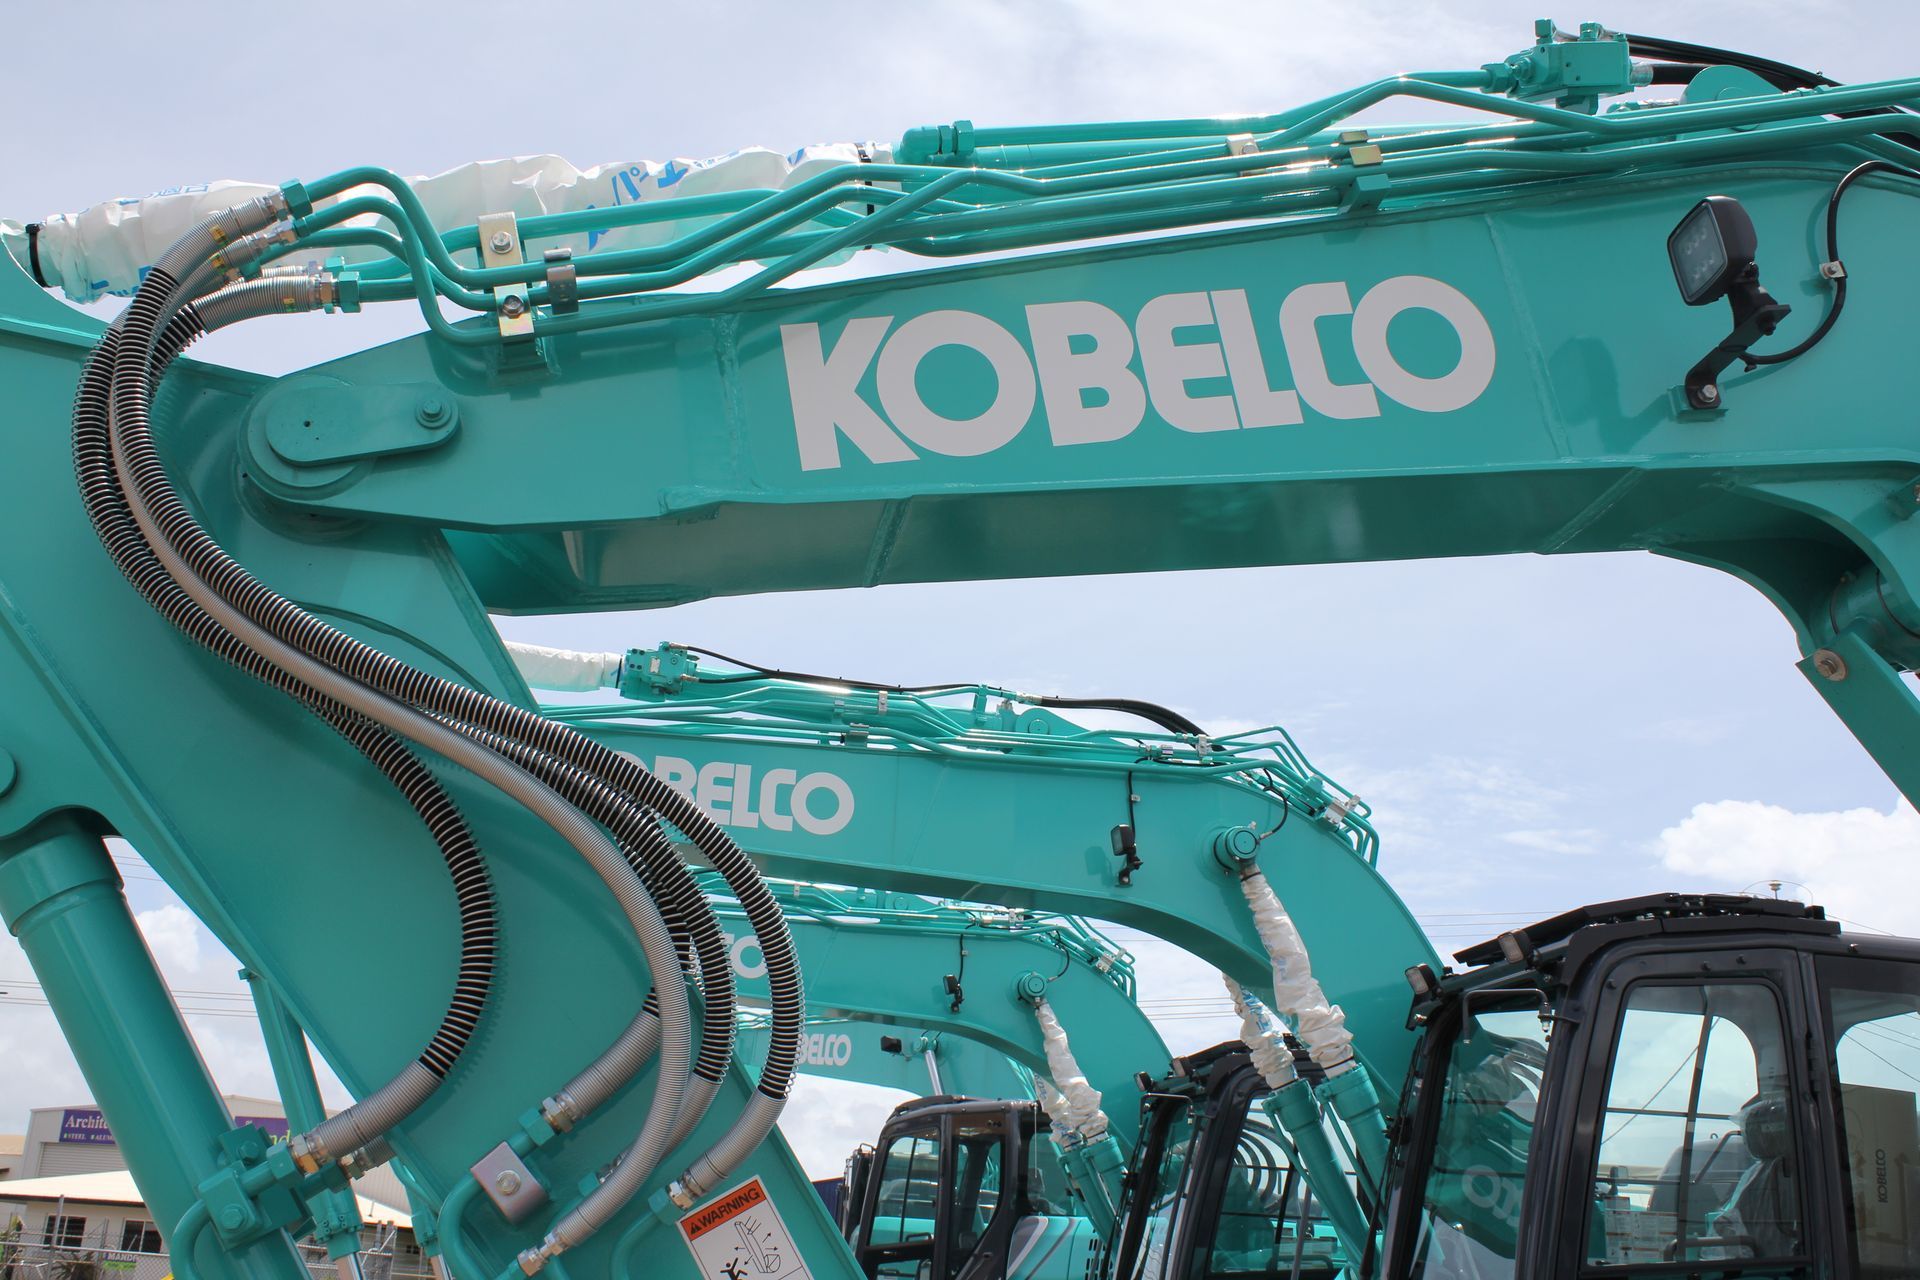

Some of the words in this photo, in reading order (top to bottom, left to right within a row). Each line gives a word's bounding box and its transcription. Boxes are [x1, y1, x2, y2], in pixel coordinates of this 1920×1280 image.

[779, 275, 1496, 471] KOBELCO
[612, 750, 855, 835] BELCO
[698, 1188, 760, 1228] WARNING
[1875, 1148, 1889, 1204] KOBELCO
